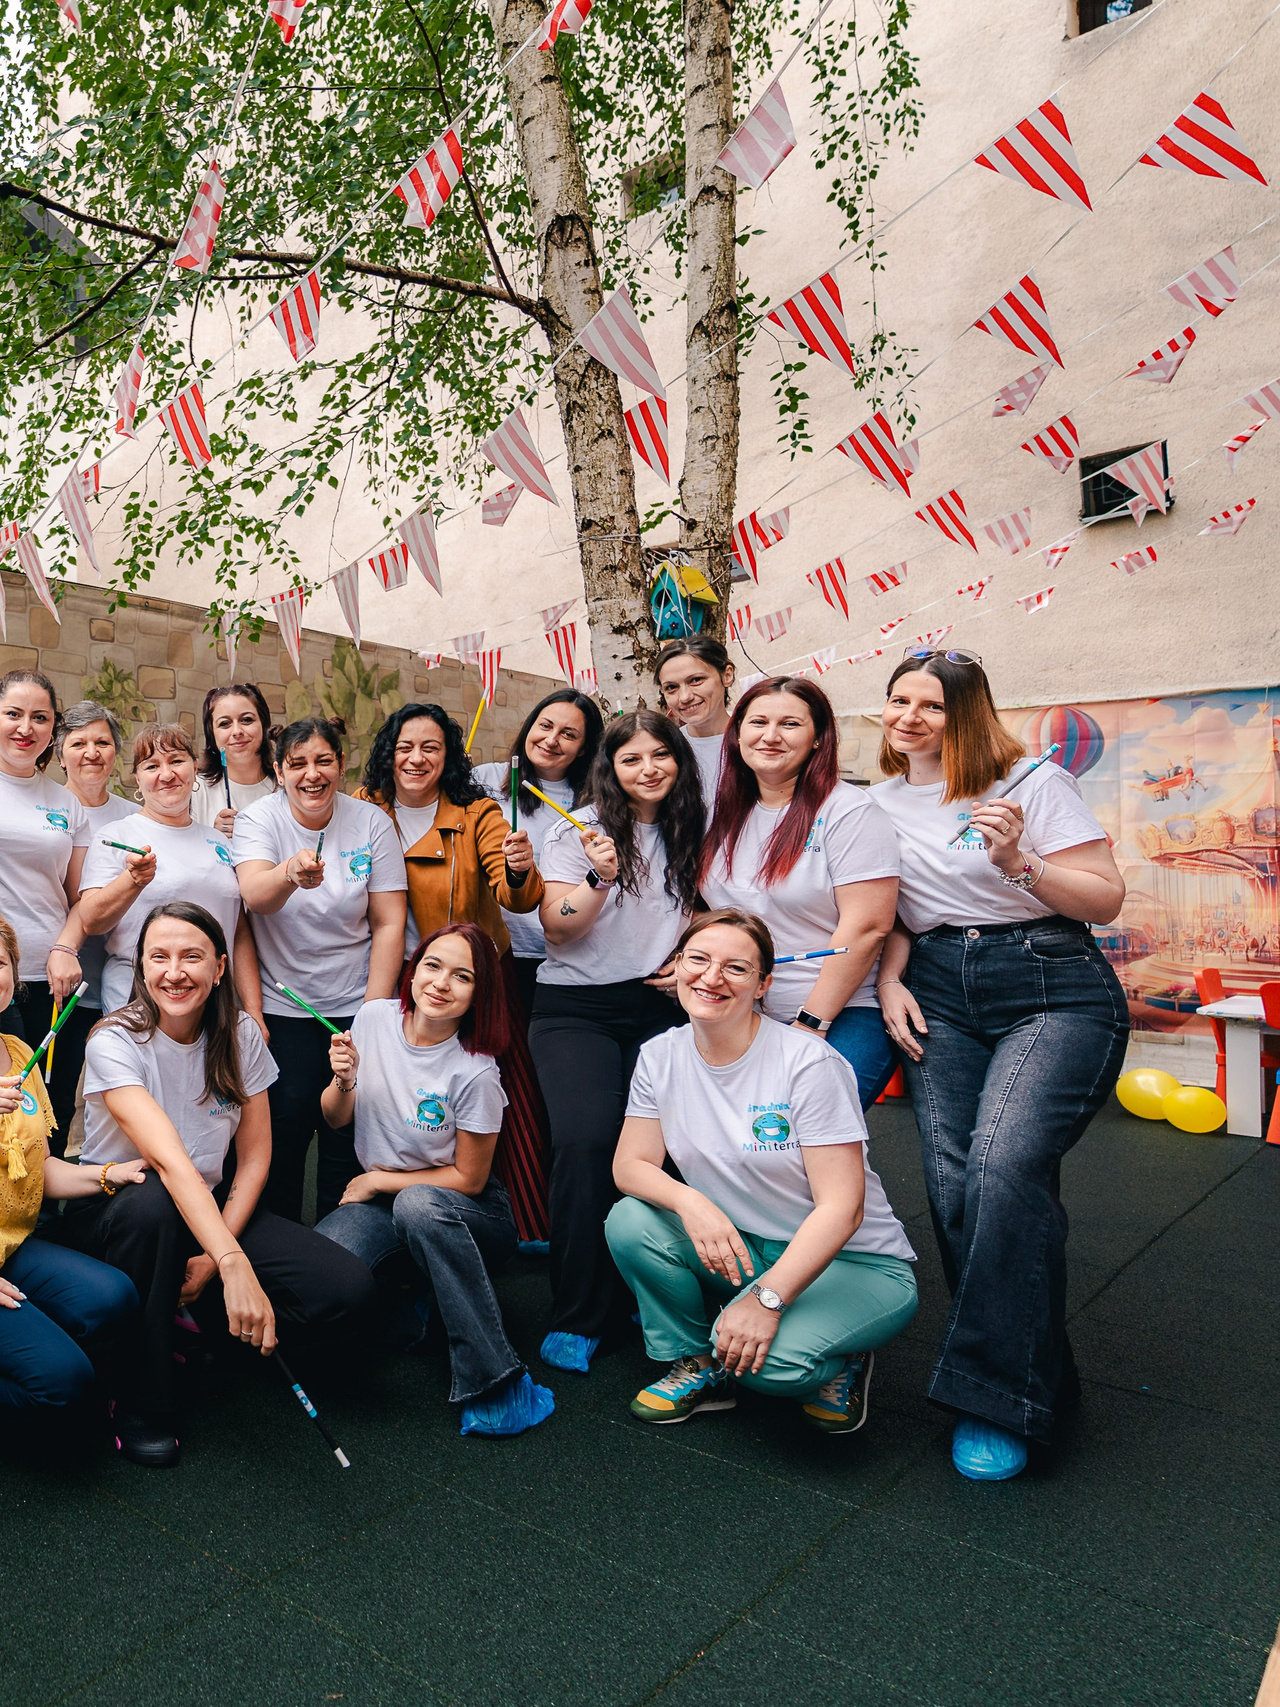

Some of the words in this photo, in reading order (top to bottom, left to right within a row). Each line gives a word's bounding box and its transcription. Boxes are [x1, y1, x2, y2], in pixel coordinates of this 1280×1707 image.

[345, 873, 369, 883] Minit
[404, 1117, 450, 1133] Miniterra
[742, 1140, 800, 1152] Miniterra
